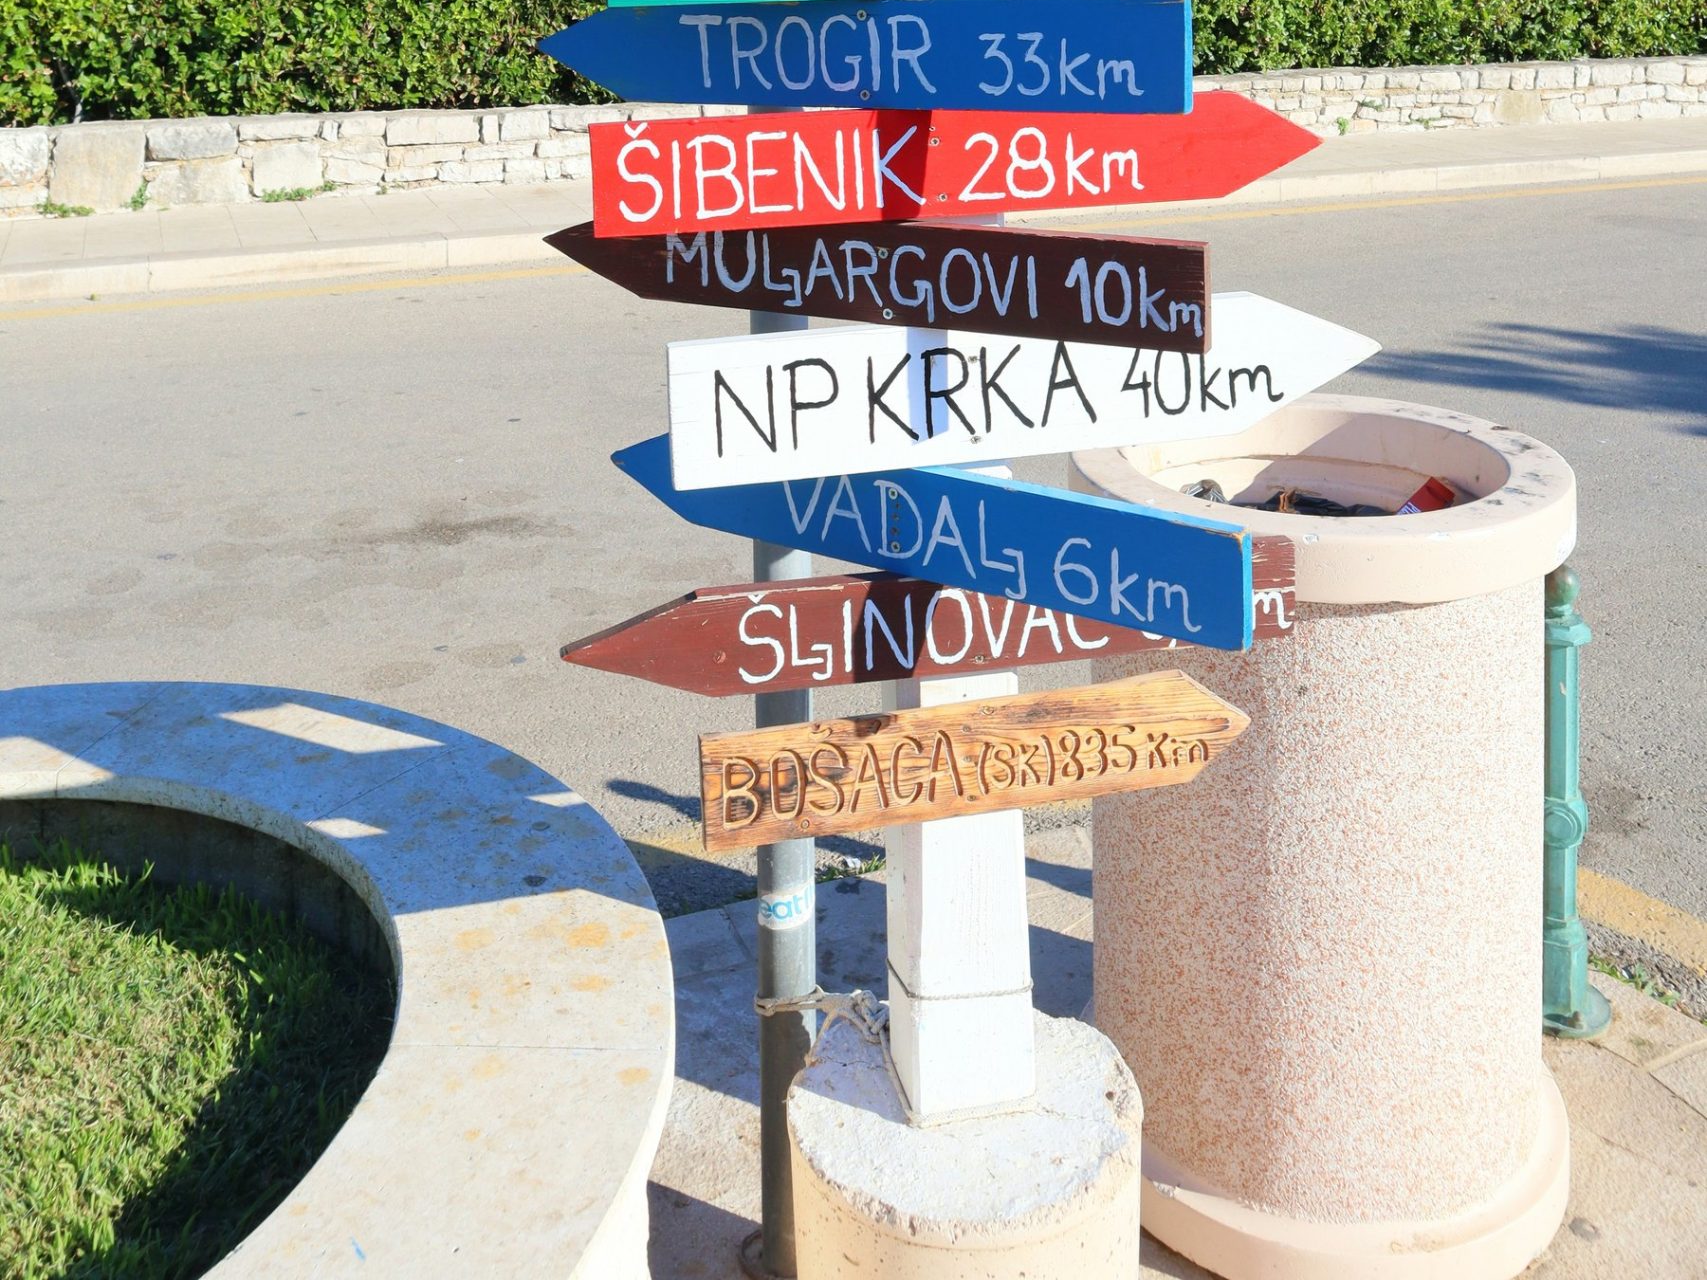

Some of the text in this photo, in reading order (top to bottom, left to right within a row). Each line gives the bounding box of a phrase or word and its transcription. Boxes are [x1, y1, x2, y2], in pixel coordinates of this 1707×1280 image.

[679, 14, 935, 95] TROGIR
[615, 122, 927, 223] ŠIBENIK
[714, 358, 839, 458] NP
[867, 339, 1097, 444] KRKA
